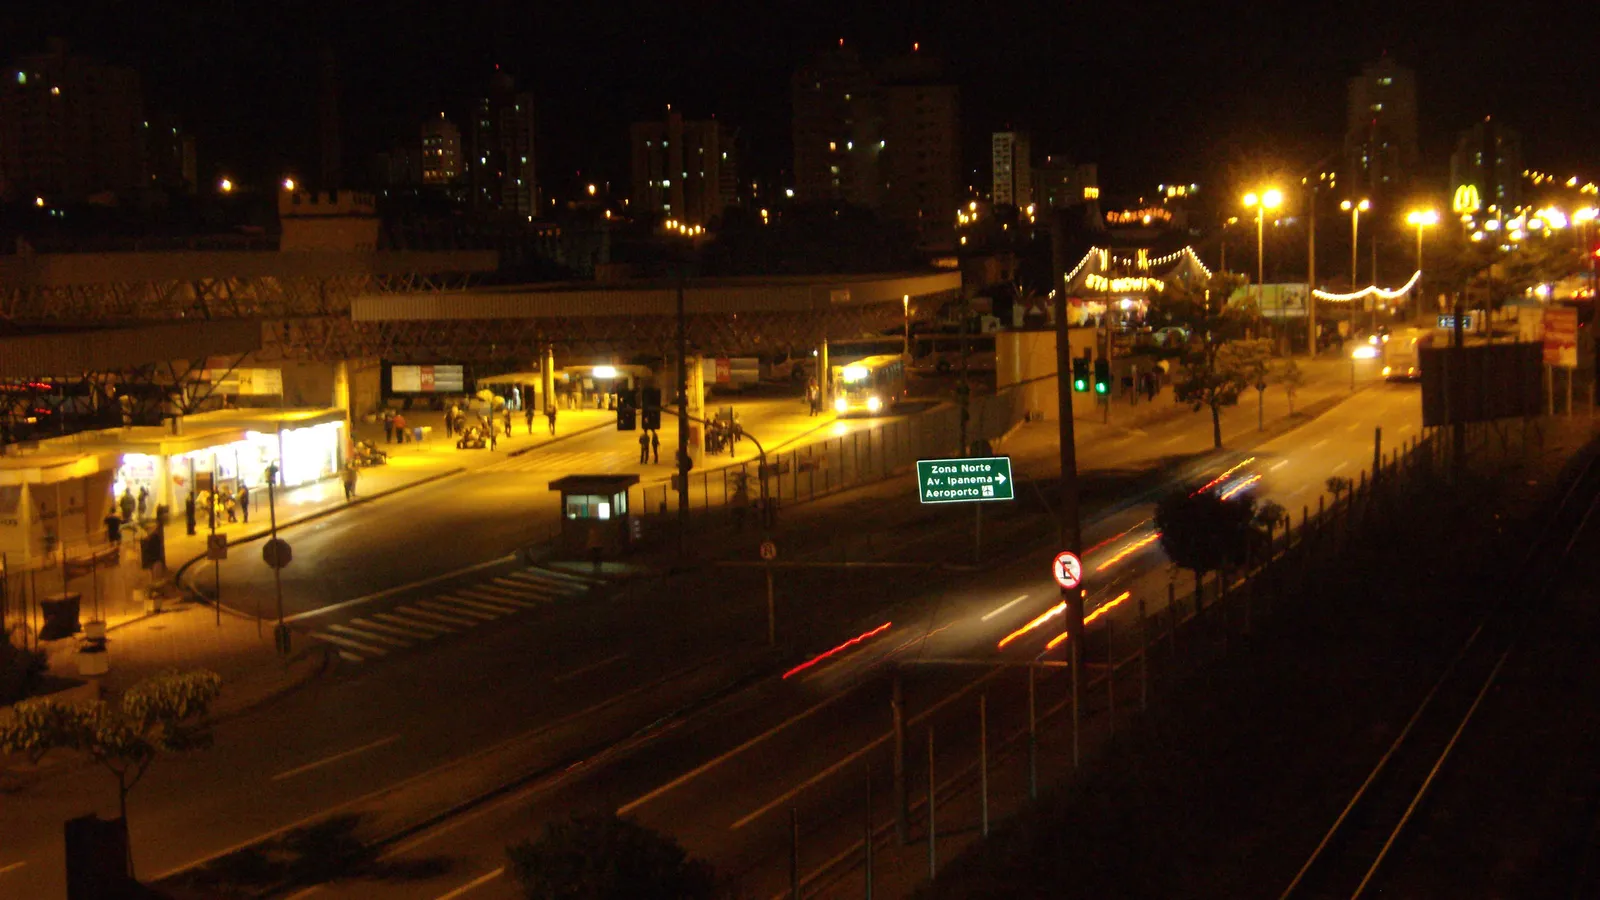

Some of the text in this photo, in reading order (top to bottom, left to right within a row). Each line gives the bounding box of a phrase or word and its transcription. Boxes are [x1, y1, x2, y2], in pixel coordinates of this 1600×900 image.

[931, 463, 992, 474] Zona Norte
[927, 475, 993, 487] Av. Ipanema
[925, 487, 979, 498] Aeroporto
[1062, 560, 1073, 580] E
